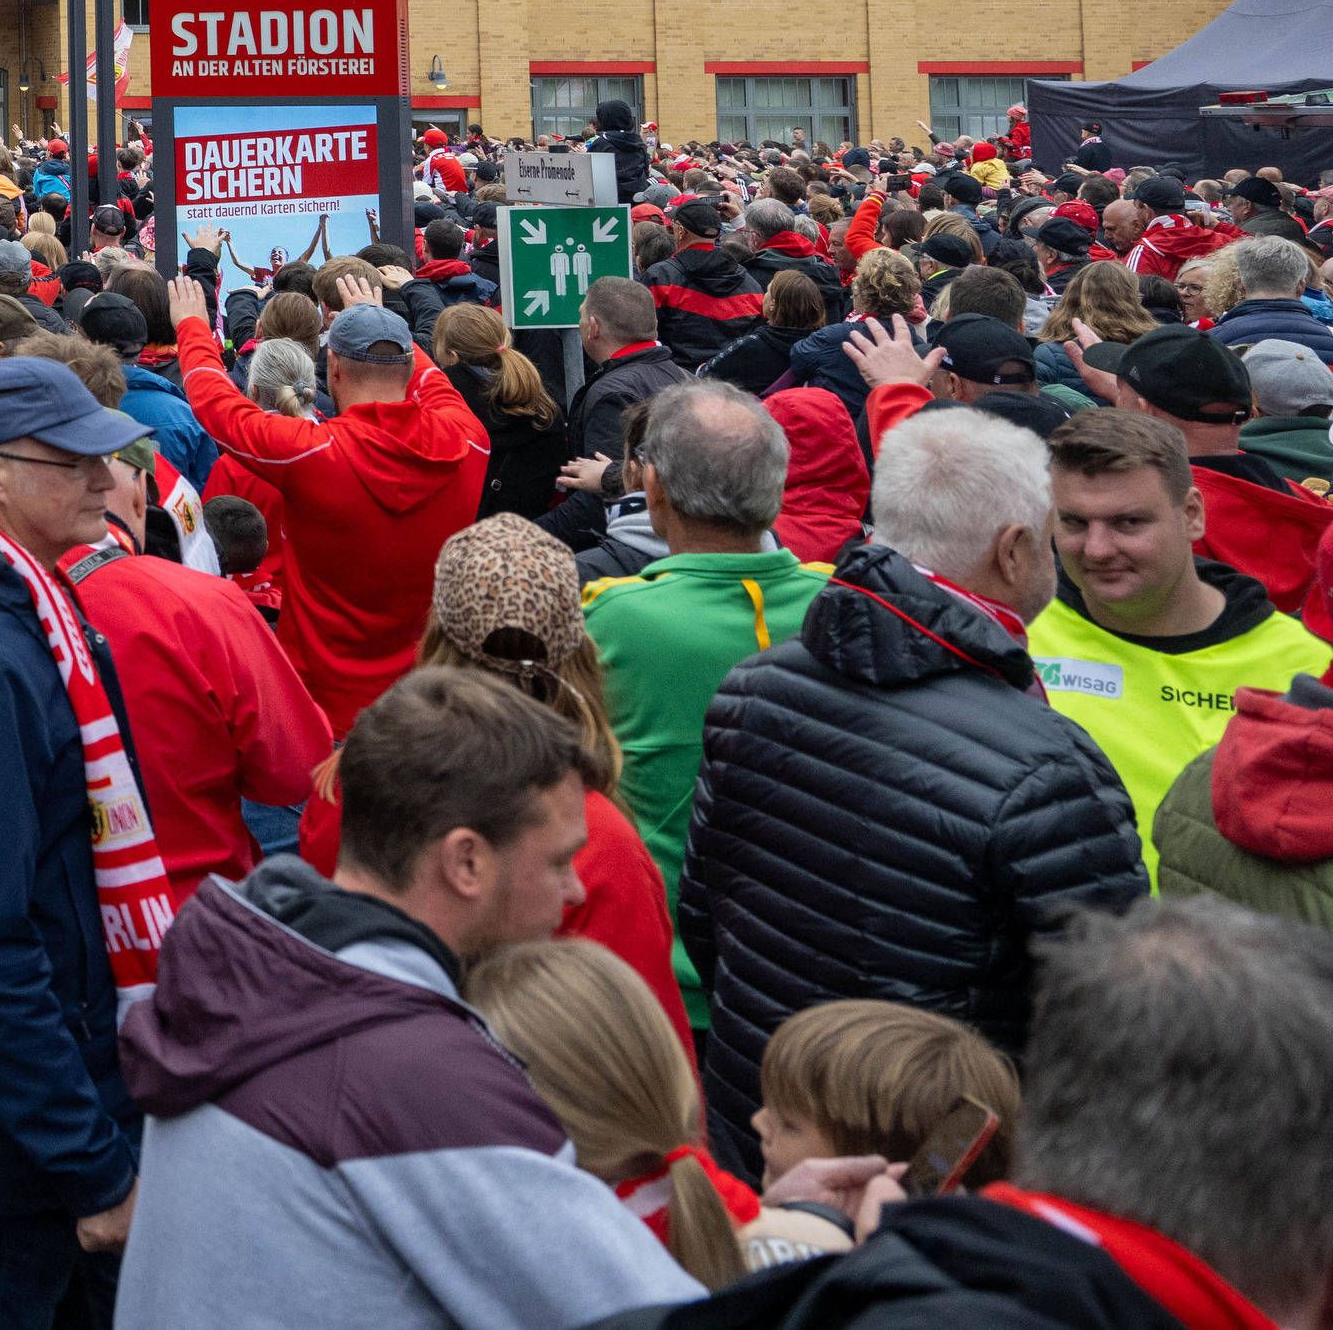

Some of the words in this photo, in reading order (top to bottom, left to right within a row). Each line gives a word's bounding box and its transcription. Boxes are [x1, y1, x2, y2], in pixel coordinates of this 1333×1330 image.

[171, 8, 375, 56] STADION
[172, 61, 194, 77] AN
[199, 60, 229, 76] DER
[233, 59, 283, 76] ALTEN
[288, 55, 375, 76] FÖRSTEREI
[184, 130, 368, 171] DAUERKARTE
[185, 165, 303, 201] SICHERN
[186, 206, 214, 219] statt
[215, 204, 258, 217] dauernd
[260, 201, 296, 215] Karten
[298, 199, 341, 213] sichern!
[1160, 685, 1237, 712] SICHE
[100, 893, 175, 953] RLIN
